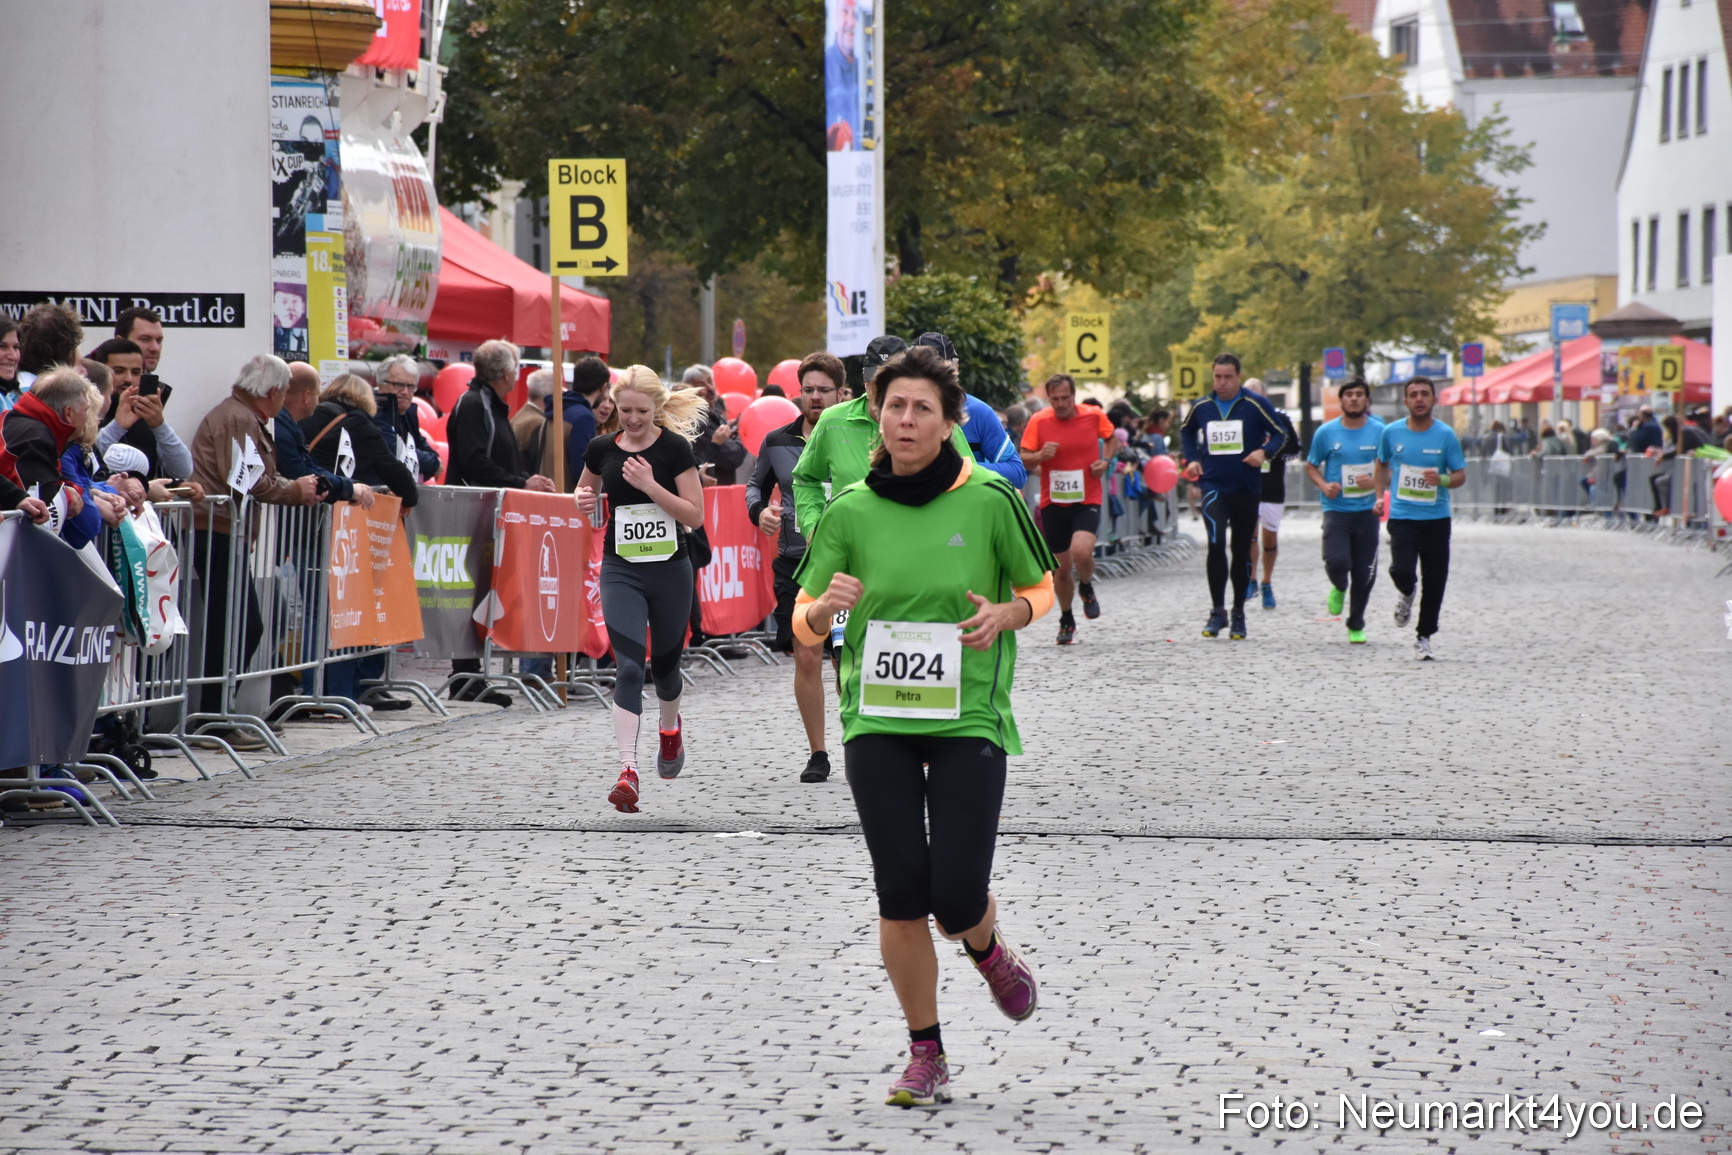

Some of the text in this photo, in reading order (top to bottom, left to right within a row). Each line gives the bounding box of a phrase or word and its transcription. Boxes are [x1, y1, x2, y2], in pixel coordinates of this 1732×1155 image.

[287, 155, 304, 169] CUP
[558, 165, 617, 184] Block
[570, 195, 608, 250] B
[310, 250, 332, 272] 18.
[0, 297, 235, 323] wwINIartl.de
[1071, 316, 1104, 328] Block
[1077, 332, 1098, 363] C
[1180, 367, 1196, 389] D
[1661, 359, 1678, 381] D
[1212, 431, 1237, 442] 5157
[1054, 480, 1078, 491] 5214
[623, 521, 667, 541] 5025
[639, 545, 653, 553] Lisa
[875, 651, 944, 681] 5024
[895, 690, 921, 701] Petra
